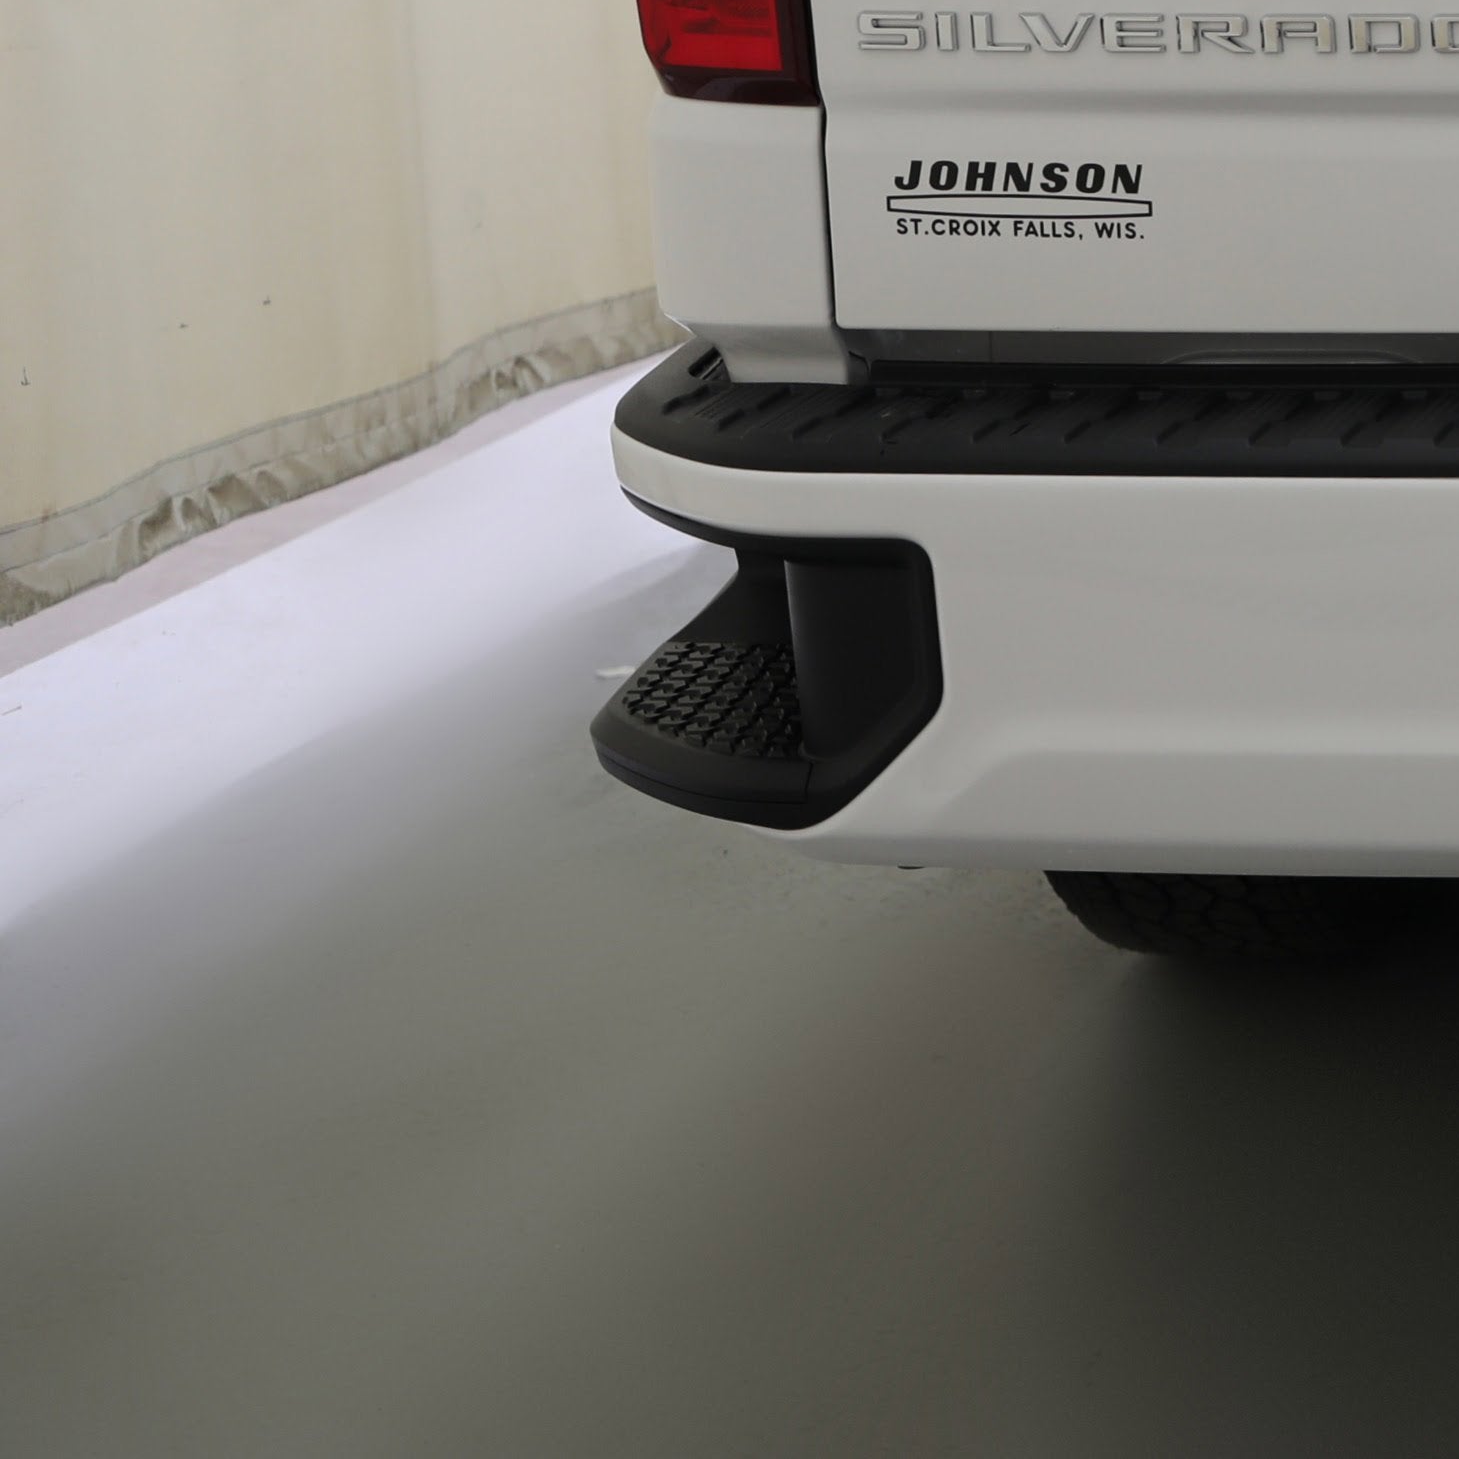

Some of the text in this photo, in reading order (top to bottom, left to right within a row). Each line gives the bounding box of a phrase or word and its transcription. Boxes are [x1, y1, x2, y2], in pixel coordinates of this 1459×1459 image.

[894, 159, 1143, 195] JOHNSON
[1012, 219, 1084, 241] FALLS,
[1094, 221, 1145, 240] WIS.
